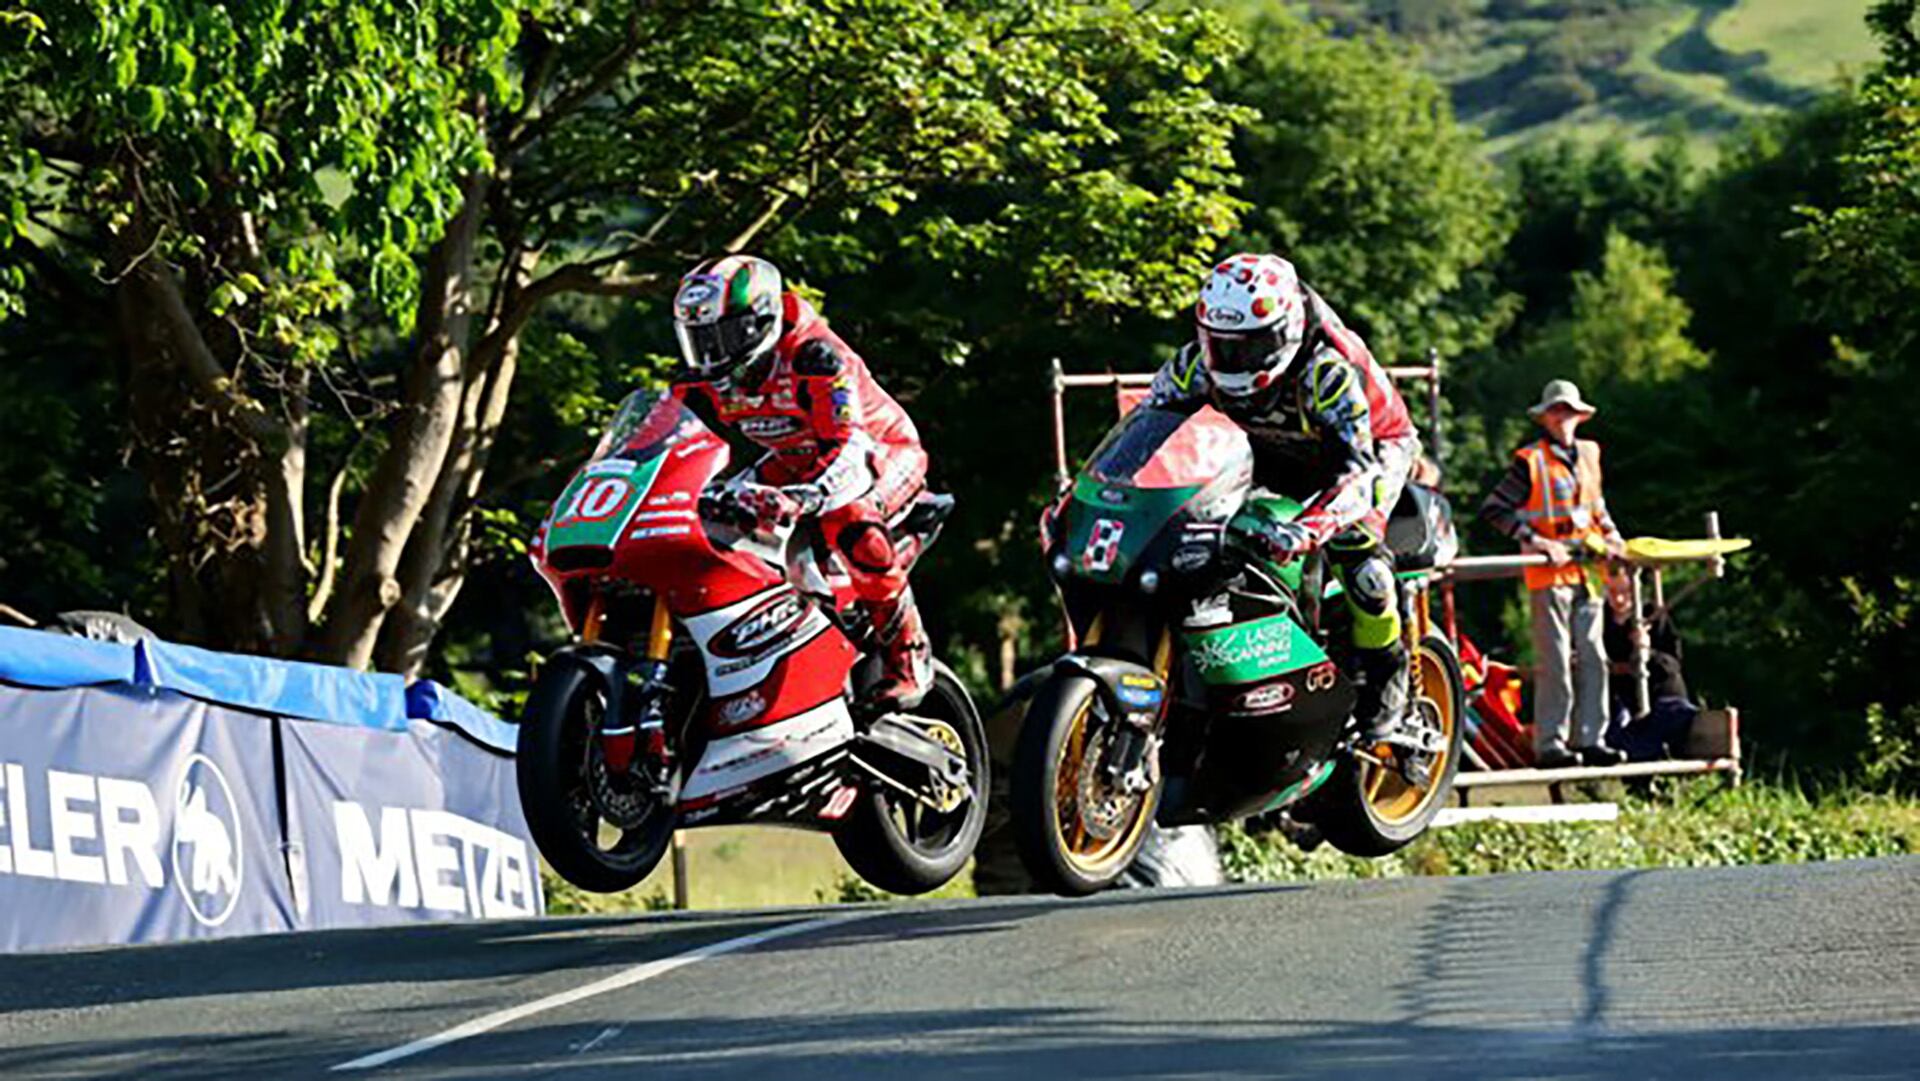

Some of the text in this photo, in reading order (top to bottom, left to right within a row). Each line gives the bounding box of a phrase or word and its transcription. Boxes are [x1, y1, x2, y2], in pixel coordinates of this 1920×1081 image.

[561, 477, 630, 521] 10
[1083, 518, 1124, 571] 8
[1246, 622, 1292, 645] LASER
[1224, 638, 1292, 664] SCANNING
[821, 786, 858, 818] 10
